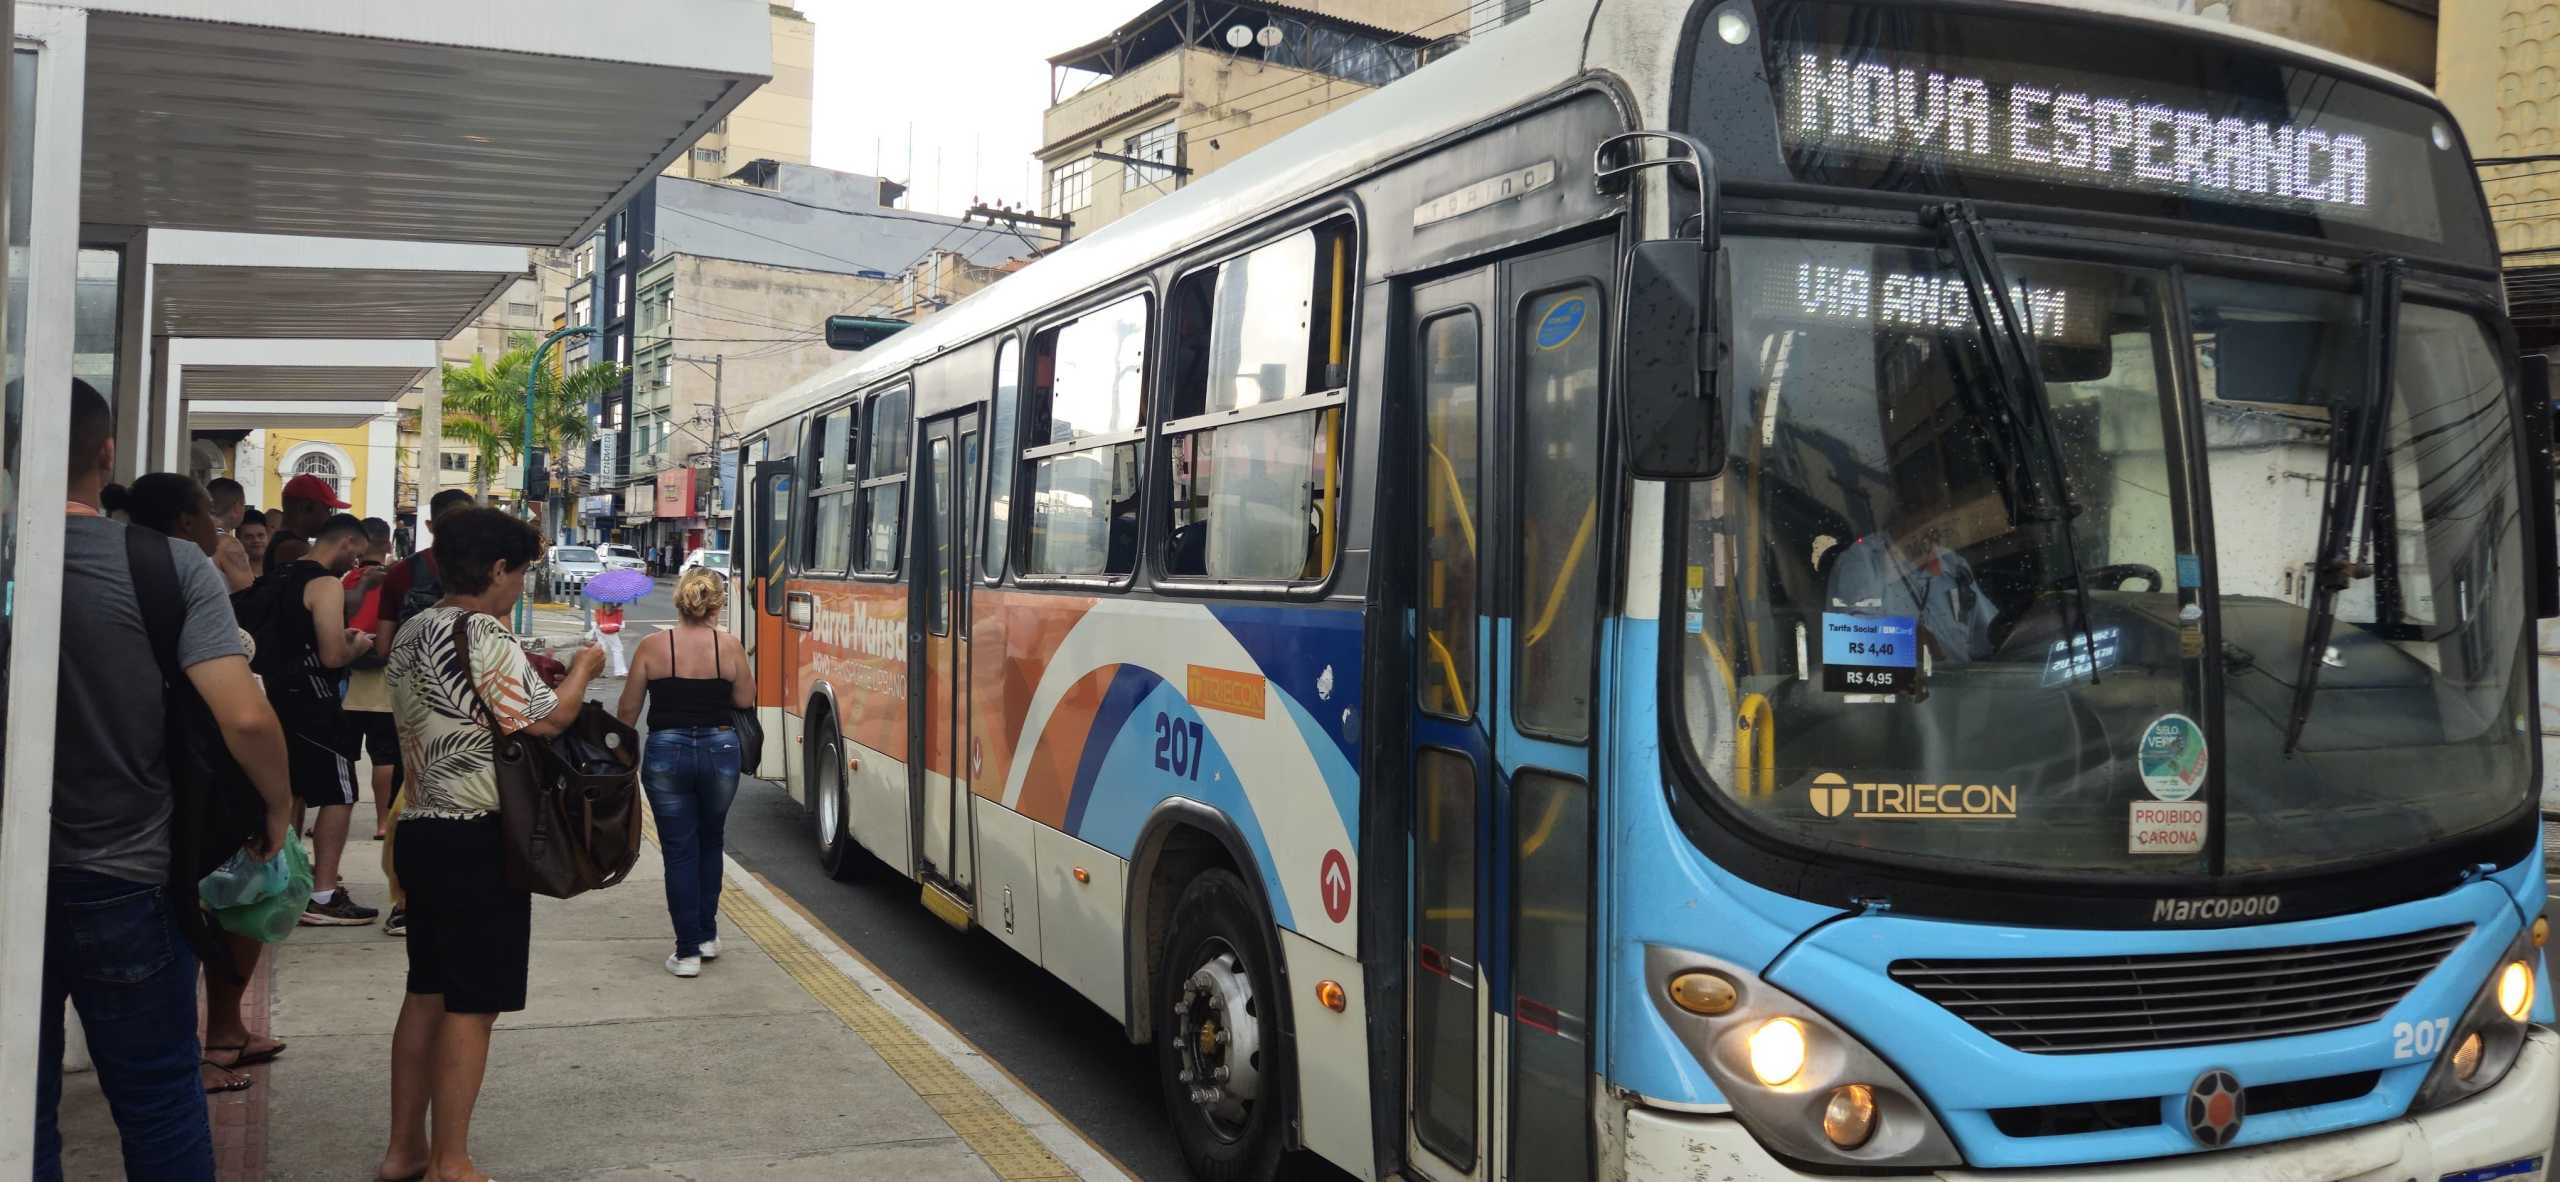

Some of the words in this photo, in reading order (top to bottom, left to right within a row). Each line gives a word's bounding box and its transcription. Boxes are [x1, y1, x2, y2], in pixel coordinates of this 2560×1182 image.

[1799, 54, 1991, 154] NOVA
[2010, 83, 2367, 205] ESPERANCA
[1799, 263, 1869, 319] VIA
[812, 595, 850, 649] Barra
[853, 600, 907, 664] Mansa
[1829, 624, 1852, 633] Tarifa
[1854, 625, 1878, 633] Social
[1868, 643, 1894, 657] 4,40
[1866, 673, 1893, 688] 4,95
[2155, 725, 2179, 735] SELO
[1154, 711, 1203, 782] 207
[1853, 783, 2017, 815] TRIECON
[2135, 810, 2203, 824] PROIBIDO
[2138, 831, 2199, 845] CARONA
[2152, 895, 2281, 922] Marcopolo
[2393, 1017, 2449, 1059] 207
